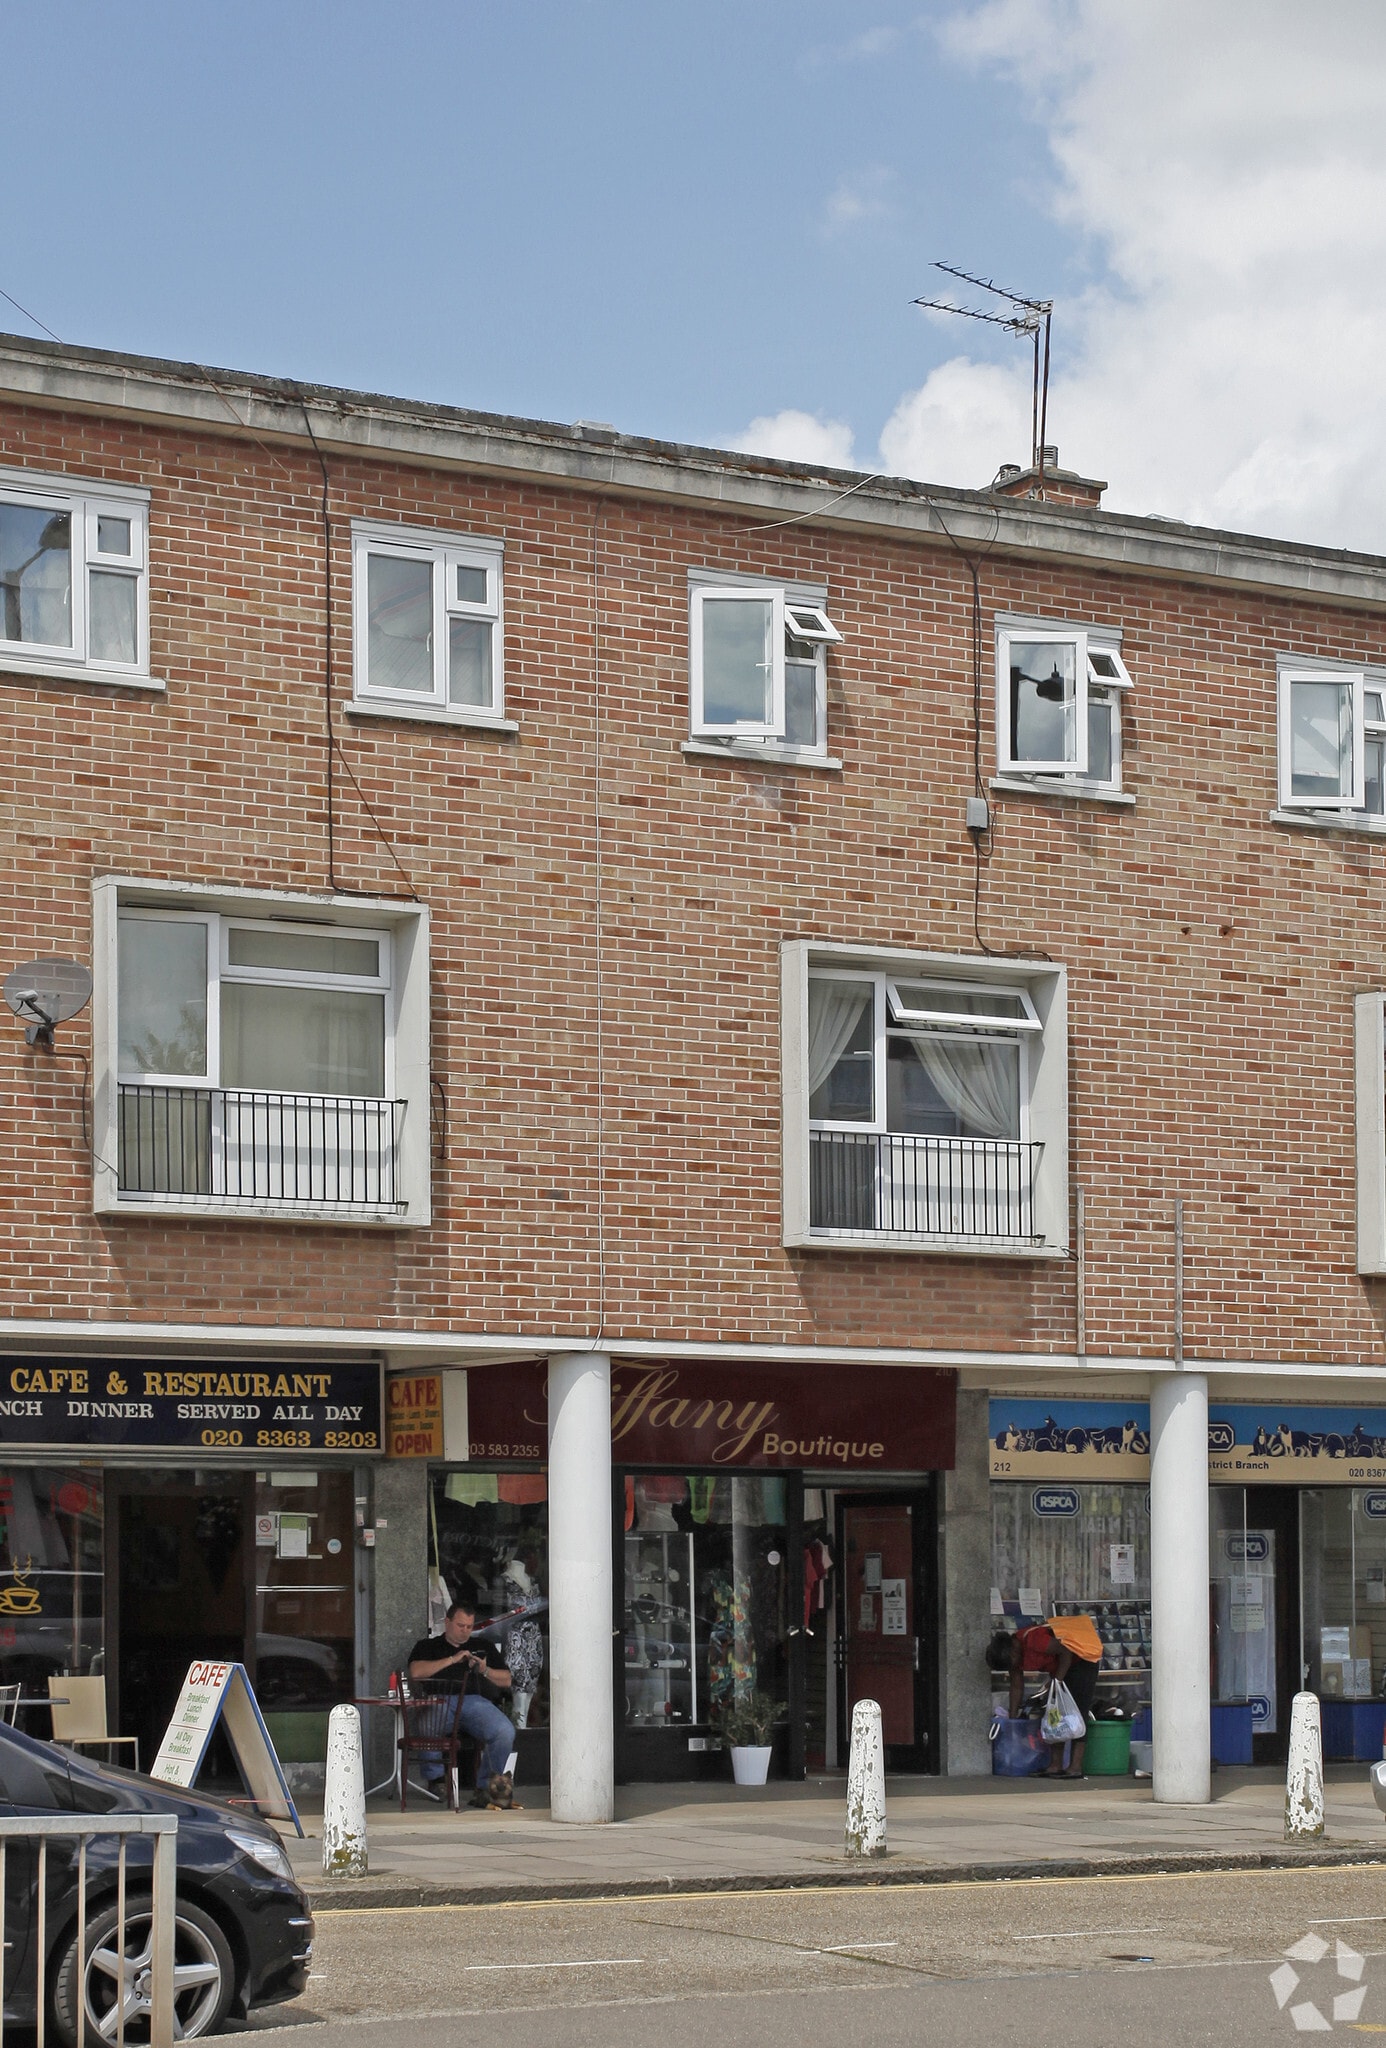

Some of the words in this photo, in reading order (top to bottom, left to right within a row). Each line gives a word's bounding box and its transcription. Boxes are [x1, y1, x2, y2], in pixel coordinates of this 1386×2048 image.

[10, 1368, 89, 1393] CAFE
[106, 1371, 128, 1395] &
[143, 1371, 332, 1398] RESTAURANT
[389, 1379, 437, 1408] CAFE
[67, 1401, 154, 1418] DINNER
[177, 1403, 261, 1420] SERVED
[272, 1405, 314, 1421] ALL
[325, 1406, 363, 1421] DAY
[524, 1359, 780, 1463] ffany
[201, 1429, 243, 1446] 020
[256, 1430, 311, 1447] 8363
[324, 1431, 377, 1447] 8203
[395, 1433, 433, 1454] OPEN
[468, 1443, 485, 1455] 03
[488, 1444, 509, 1456] 583
[512, 1445, 540, 1457] 2355
[762, 1433, 885, 1462] Boutique
[993, 1462, 1011, 1472] 212
[1208, 1461, 1232, 1469] strict
[1236, 1461, 1270, 1469] Branch
[1349, 1468, 1364, 1478] 020
[1040, 1495, 1074, 1508] RSPCA
[1231, 1541, 1264, 1553] RSPCA
[189, 1663, 227, 1687] CAFE
[186, 1692, 210, 1704] Breakfast
[186, 1703, 203, 1713] Lunch
[182, 1712, 200, 1723] Dinner
[167, 1743, 192, 1755] Breakfast
